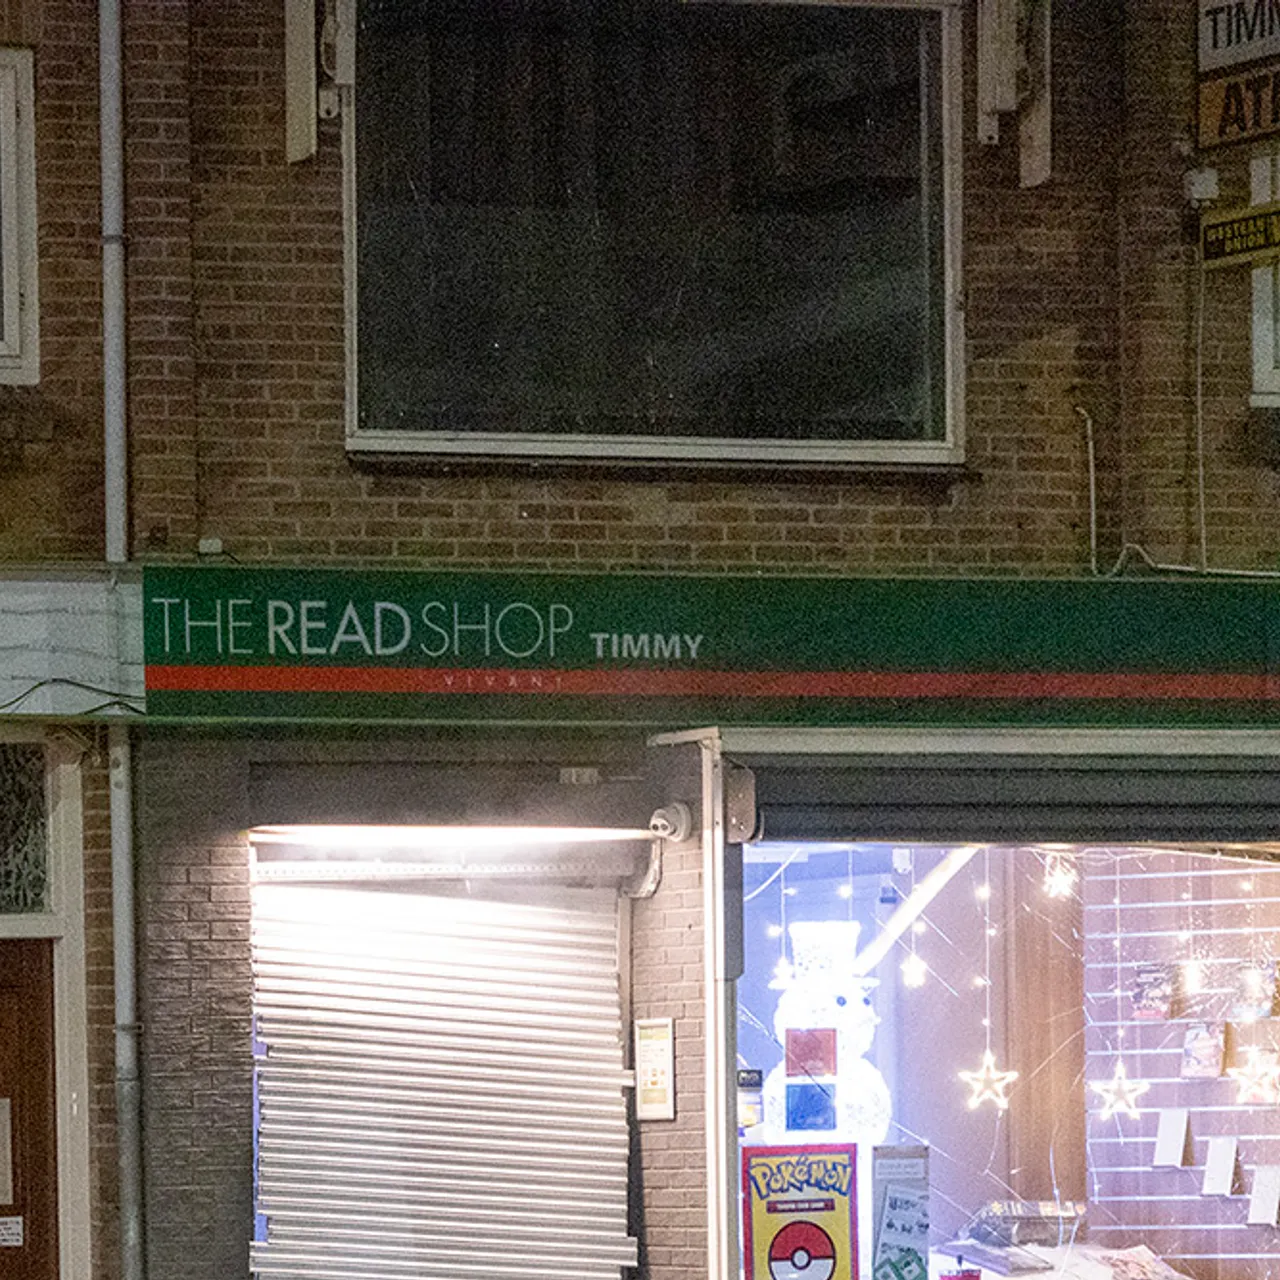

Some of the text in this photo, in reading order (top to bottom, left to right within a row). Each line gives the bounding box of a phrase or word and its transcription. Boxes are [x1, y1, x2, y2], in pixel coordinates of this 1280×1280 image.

[152, 598, 704, 660] THE READ SHOP TIMMY
